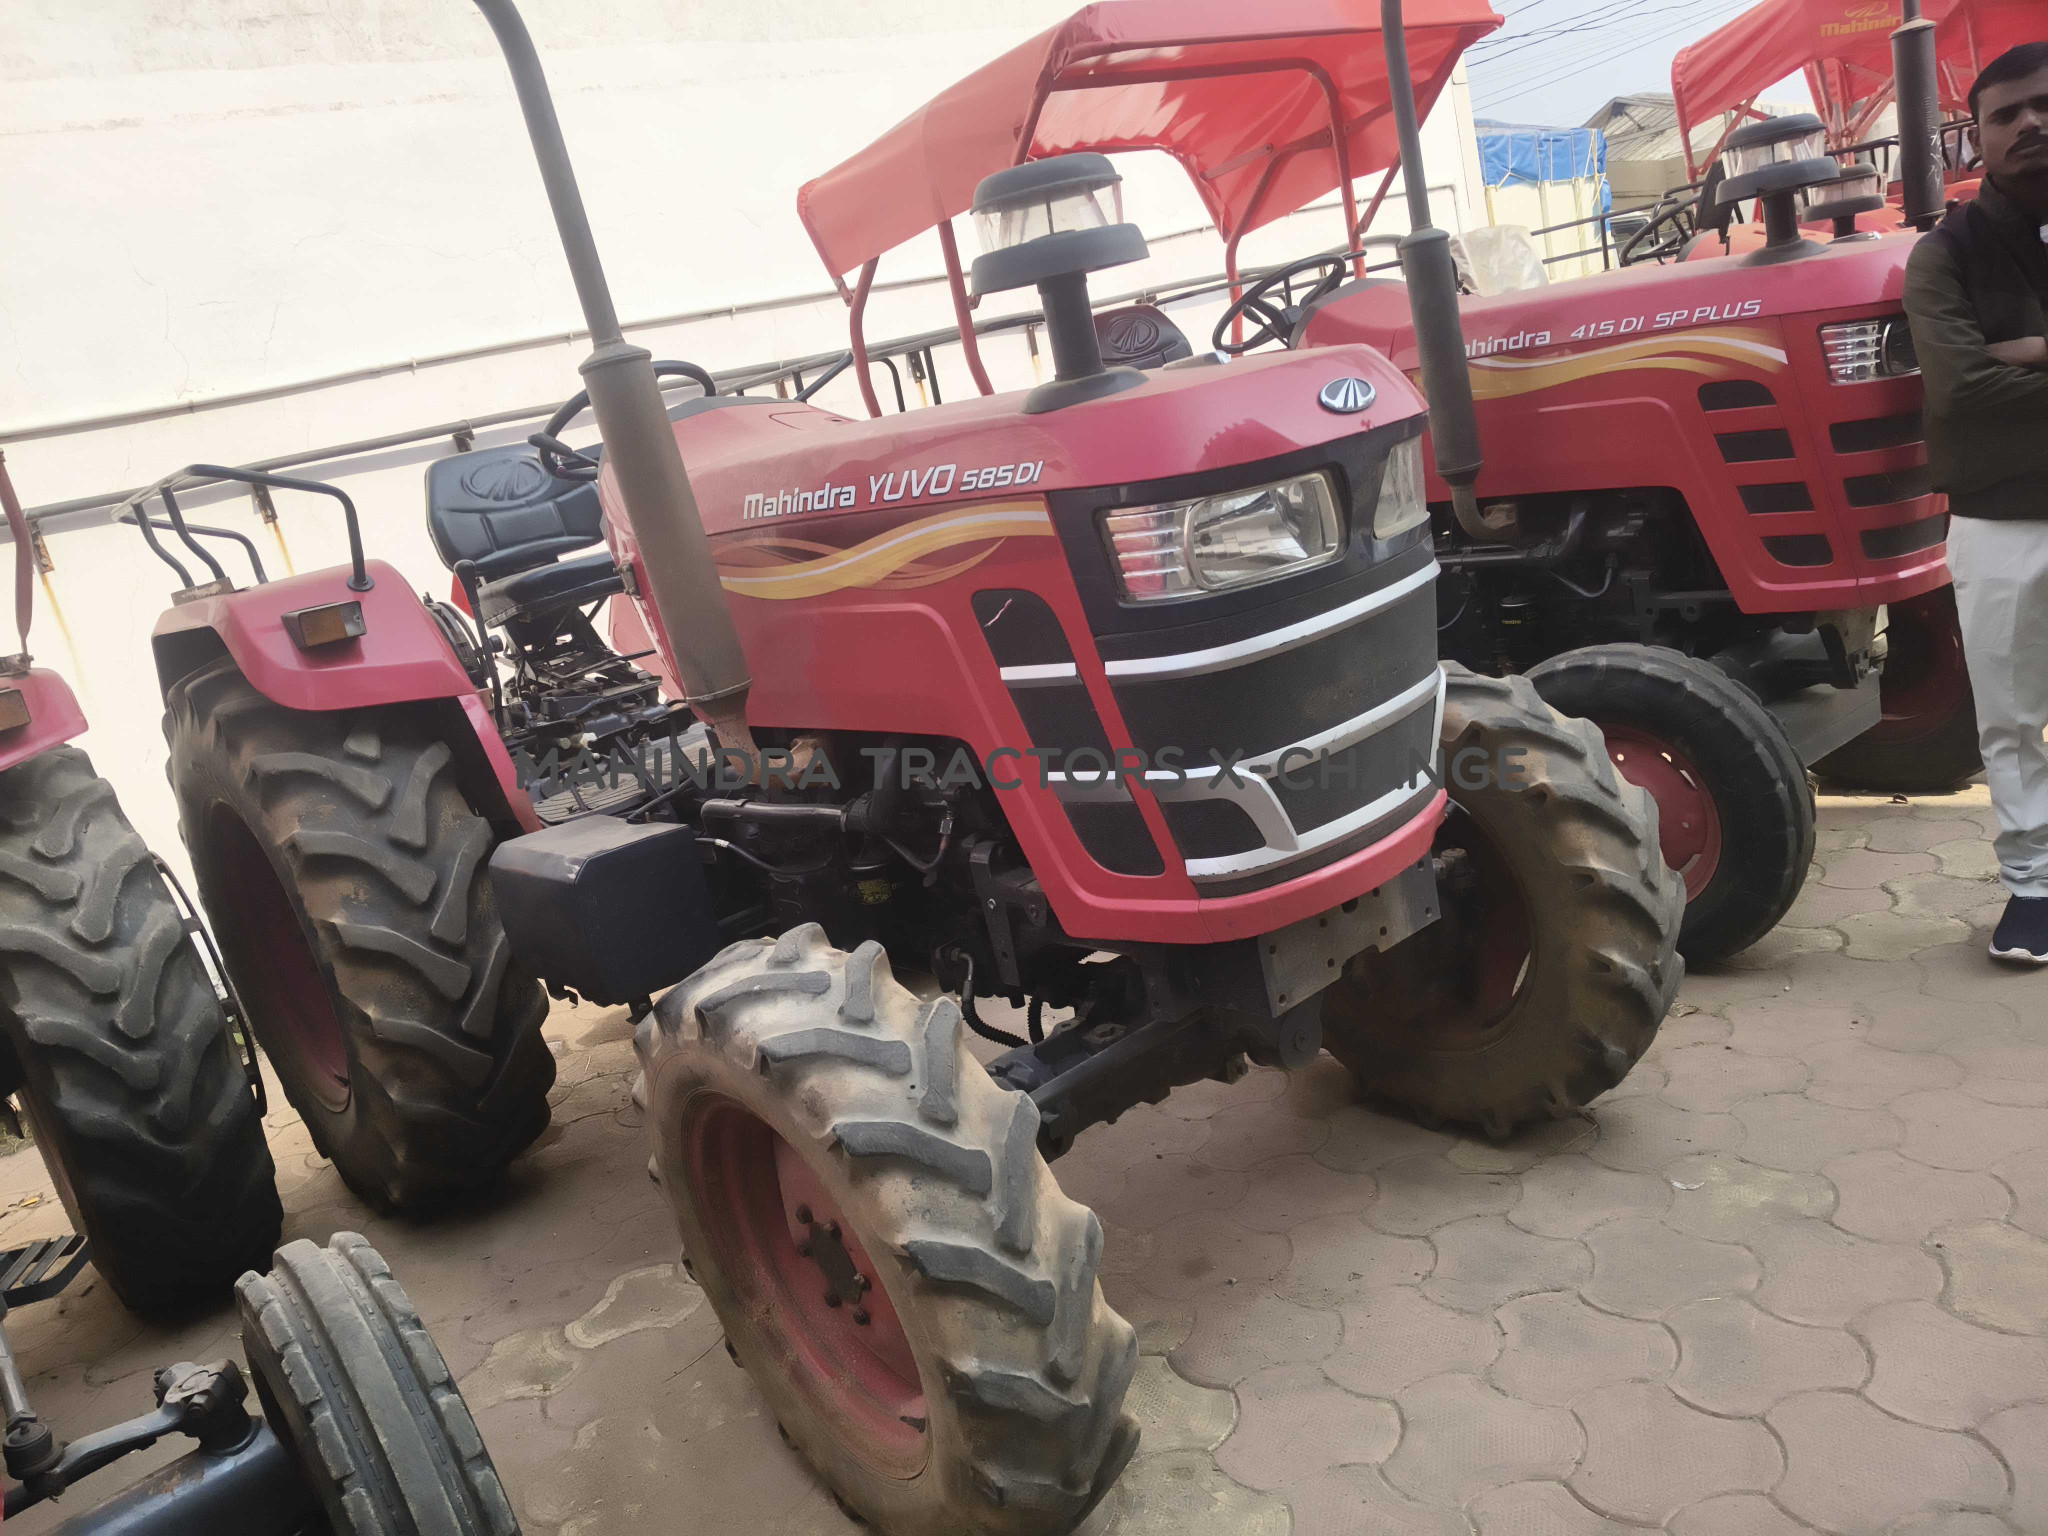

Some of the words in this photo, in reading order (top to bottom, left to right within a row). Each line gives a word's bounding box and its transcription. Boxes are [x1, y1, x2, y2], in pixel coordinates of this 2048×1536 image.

[1820, 15, 1902, 37] Mahindr
[1464, 330, 1551, 357] hindra
[1570, 320, 1616, 339] 415
[1619, 315, 1645, 333] DI
[1653, 309, 1688, 328] SP
[1692, 299, 1762, 323] PLUS
[743, 482, 856, 520] Mahindra
[869, 463, 957, 504] YUVO
